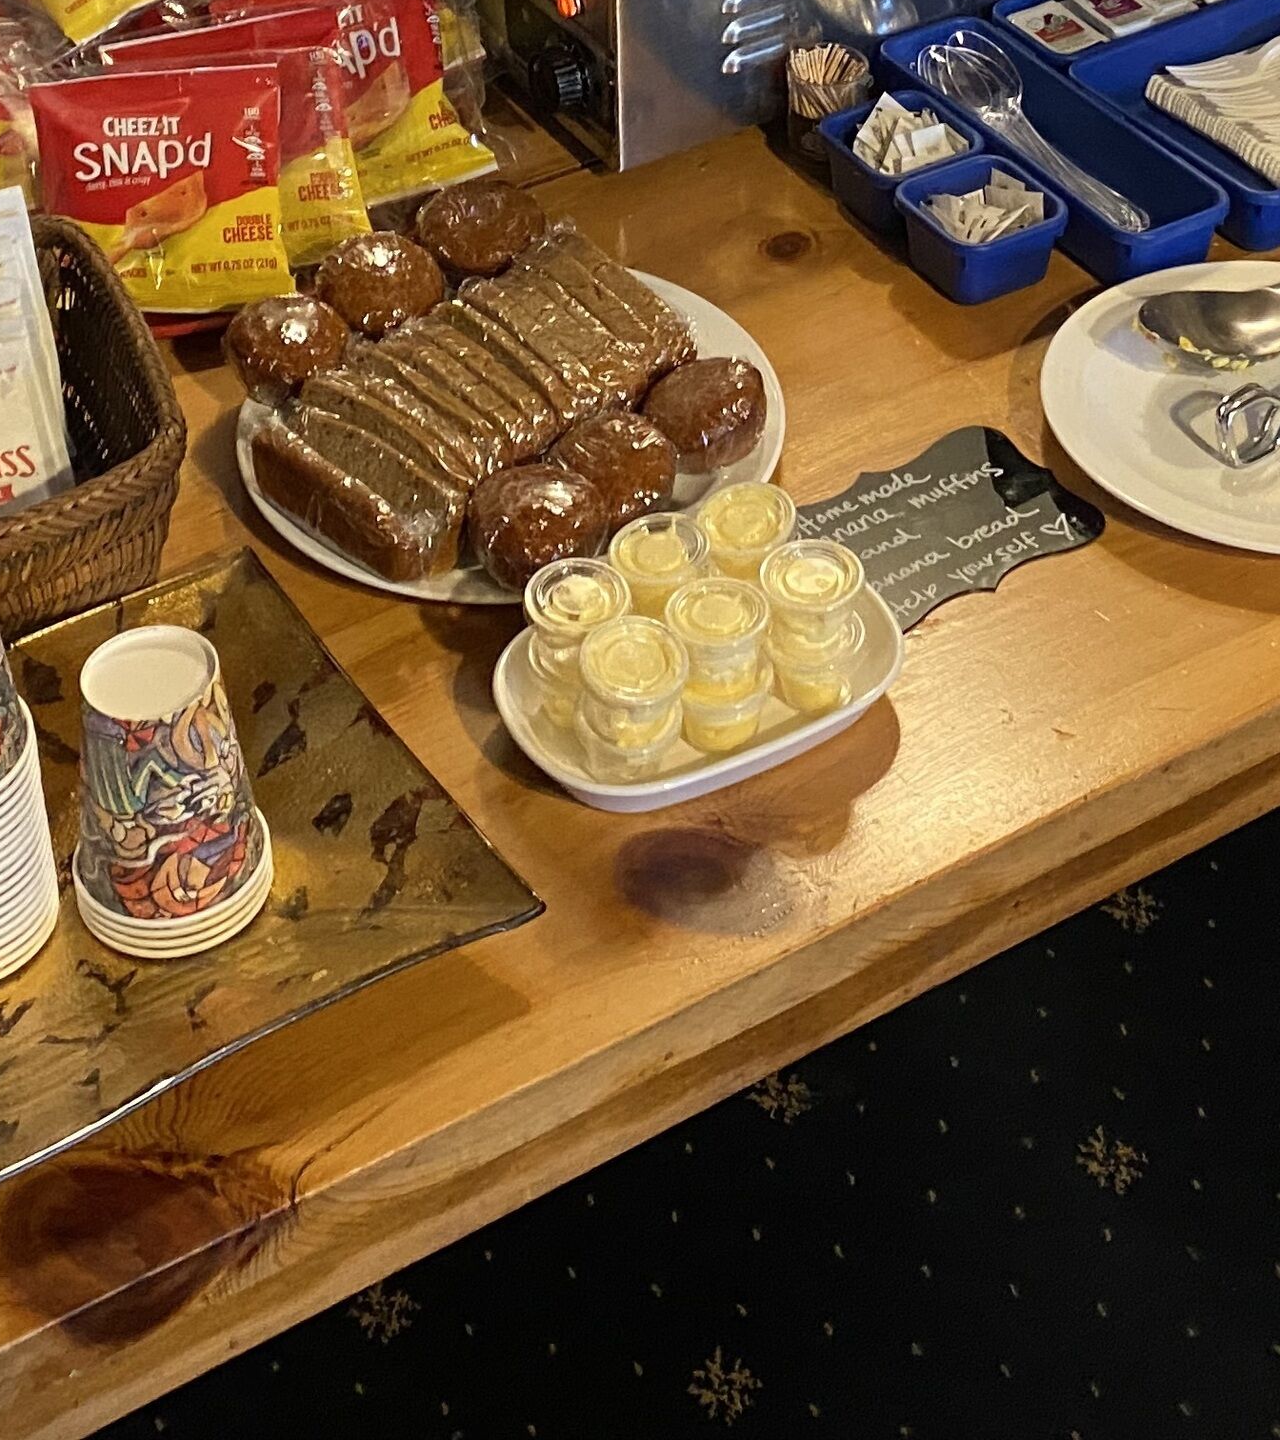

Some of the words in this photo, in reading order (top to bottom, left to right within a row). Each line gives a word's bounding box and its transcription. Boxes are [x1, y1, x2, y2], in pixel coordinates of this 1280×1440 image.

[223, 225, 275, 244] CHEESE
[235, 213, 274, 228] DOUBLE
[820, 506, 904, 544] anana
[907, 460, 1005, 510] muffins
[859, 527, 922, 561] and
[870, 549, 951, 594] anana
[946, 505, 1041, 551] bread
[946, 531, 1041, 585] yourself
